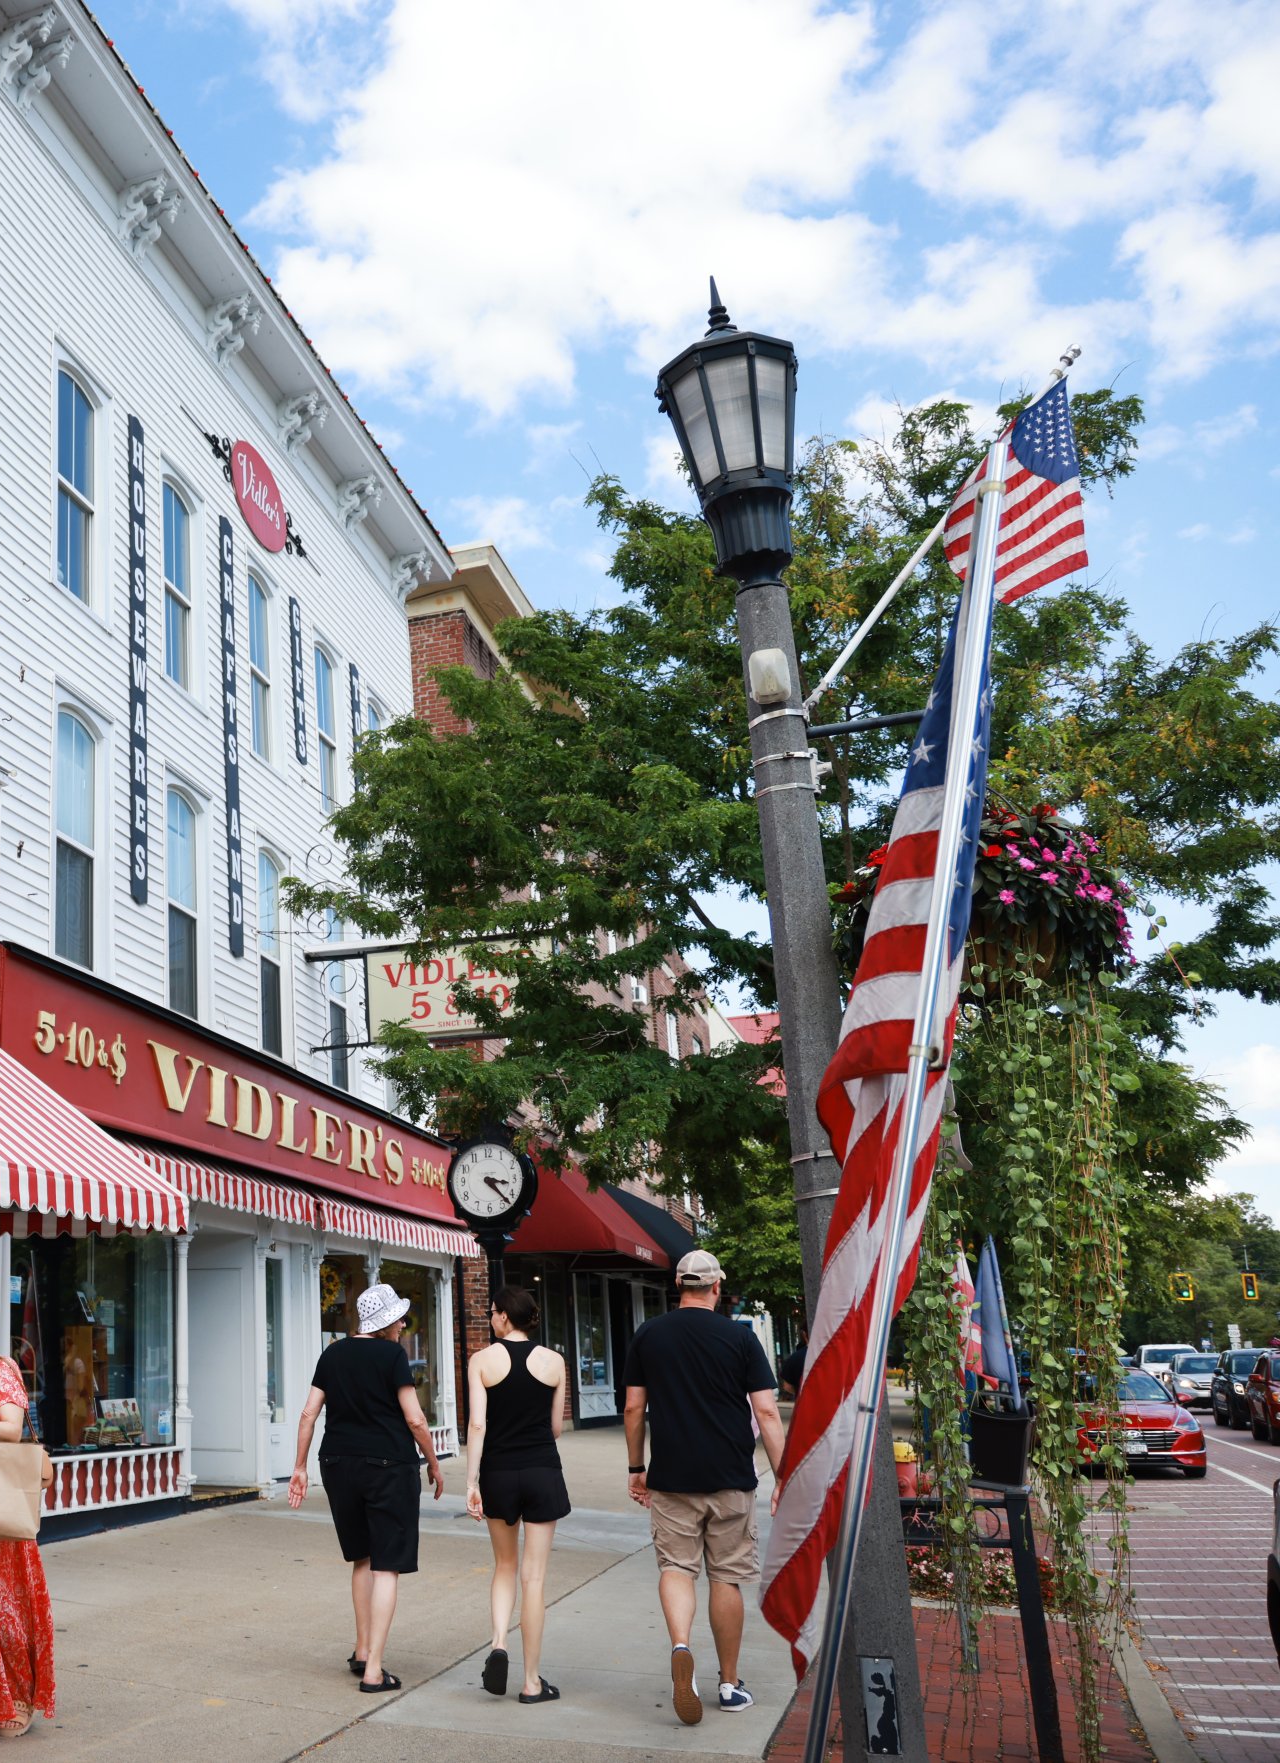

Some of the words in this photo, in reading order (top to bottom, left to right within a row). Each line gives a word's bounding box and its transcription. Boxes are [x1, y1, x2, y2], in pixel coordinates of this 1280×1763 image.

[238, 452, 280, 531] Vidler's
[132, 436, 147, 881] HOUSEWARES
[293, 604, 306, 758] GIFTS
[223, 534, 237, 765] CRAFTS
[231, 807, 242, 925] AND
[411, 991, 432, 1020] 5
[147, 1039, 404, 1186] VIDLER'S
[471, 1152, 478, 1163] 11
[484, 1148, 492, 1158] 12
[499, 1150, 504, 1160] 1
[462, 1165, 470, 1175] 10
[510, 1160, 515, 1170] 2
[461, 1177, 466, 1187] 9
[512, 1174, 517, 1184] 3
[463, 1191, 469, 1201] 8
[510, 1188, 515, 1198] 4
[475, 1201, 480, 1211] 7
[487, 1203, 493, 1213] 6
